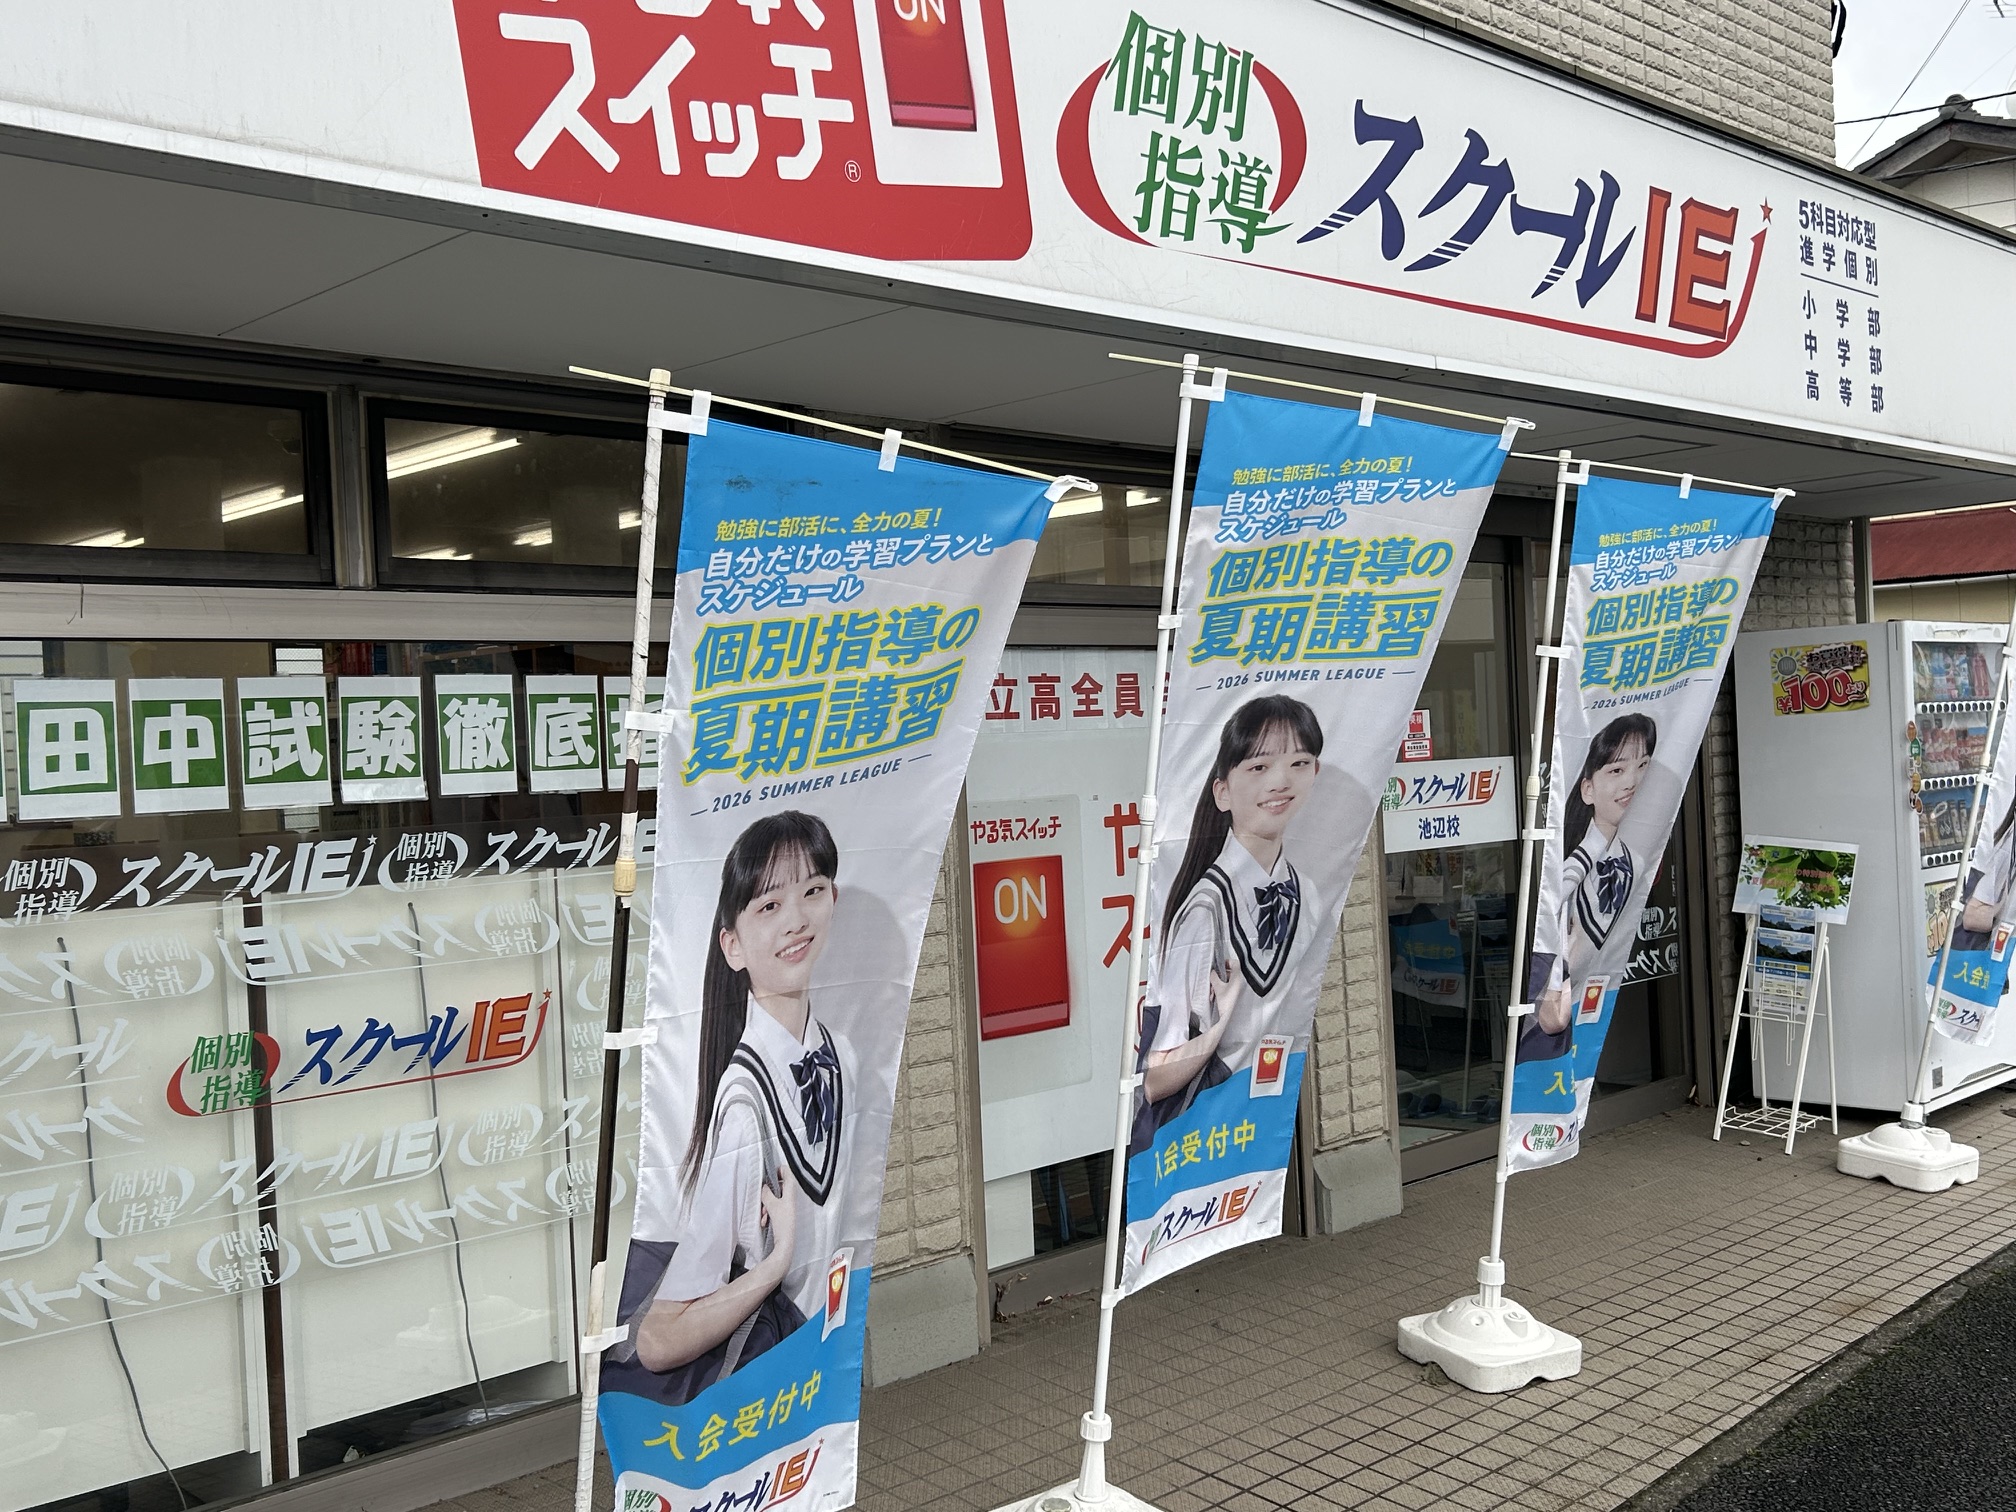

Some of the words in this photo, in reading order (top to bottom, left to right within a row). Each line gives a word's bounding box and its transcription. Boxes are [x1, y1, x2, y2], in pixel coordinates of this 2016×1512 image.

[498, 13, 855, 181] スイッチ
[1105, 10, 1255, 142] 個別
[1134, 131, 1294, 253] 指導
[1798, 199, 1878, 252] 5科目対応型
[1799, 235, 1879, 287] 進学個別
[1222, 478, 1457, 515] 自分だけの学習プランと
[1216, 509, 1346, 541] スケジュール
[705, 532, 995, 580] 自分だけの学習プランと
[1206, 535, 1455, 599] 個別指導の
[1590, 563, 1677, 592] スケジュール
[697, 575, 863, 615] スケジュール
[1585, 576, 1740, 638] 個別指導の
[693, 605, 984, 697] 個別指導の
[1187, 587, 1443, 668] 夏期講習
[1580, 613, 1733, 693] 夏期講習
[985, 672, 1170, 721] 立高全員
[1216, 674, 1249, 690] 2026
[1254, 669, 1321, 683] SUMMER
[1325, 667, 1386, 681] LEAGUE
[1590, 697, 1618, 710] 2026
[1619, 690, 1662, 705] SUMMER
[1663, 677, 1691, 697] LEAGUE
[681, 657, 967, 787] 夏期講習
[712, 789, 752, 813] 2026
[758, 774, 834, 801] SUMMER
[840, 758, 903, 785] LEAGUE
[396, 831, 448, 861] 個別
[970, 816, 1062, 844] やる気スイッチ
[1418, 815, 1460, 840] 池辺校
[3, 857, 70, 892] 個別
[403, 859, 470, 892] 指導
[993, 874, 1048, 924] ON
[14, 889, 91, 926] 指導
[190, 1030, 256, 1074] 個別
[200, 1068, 272, 1114] 指導
[1153, 1119, 1256, 1188] 入会受付中
[642, 1370, 822, 1463] 入会受付中
